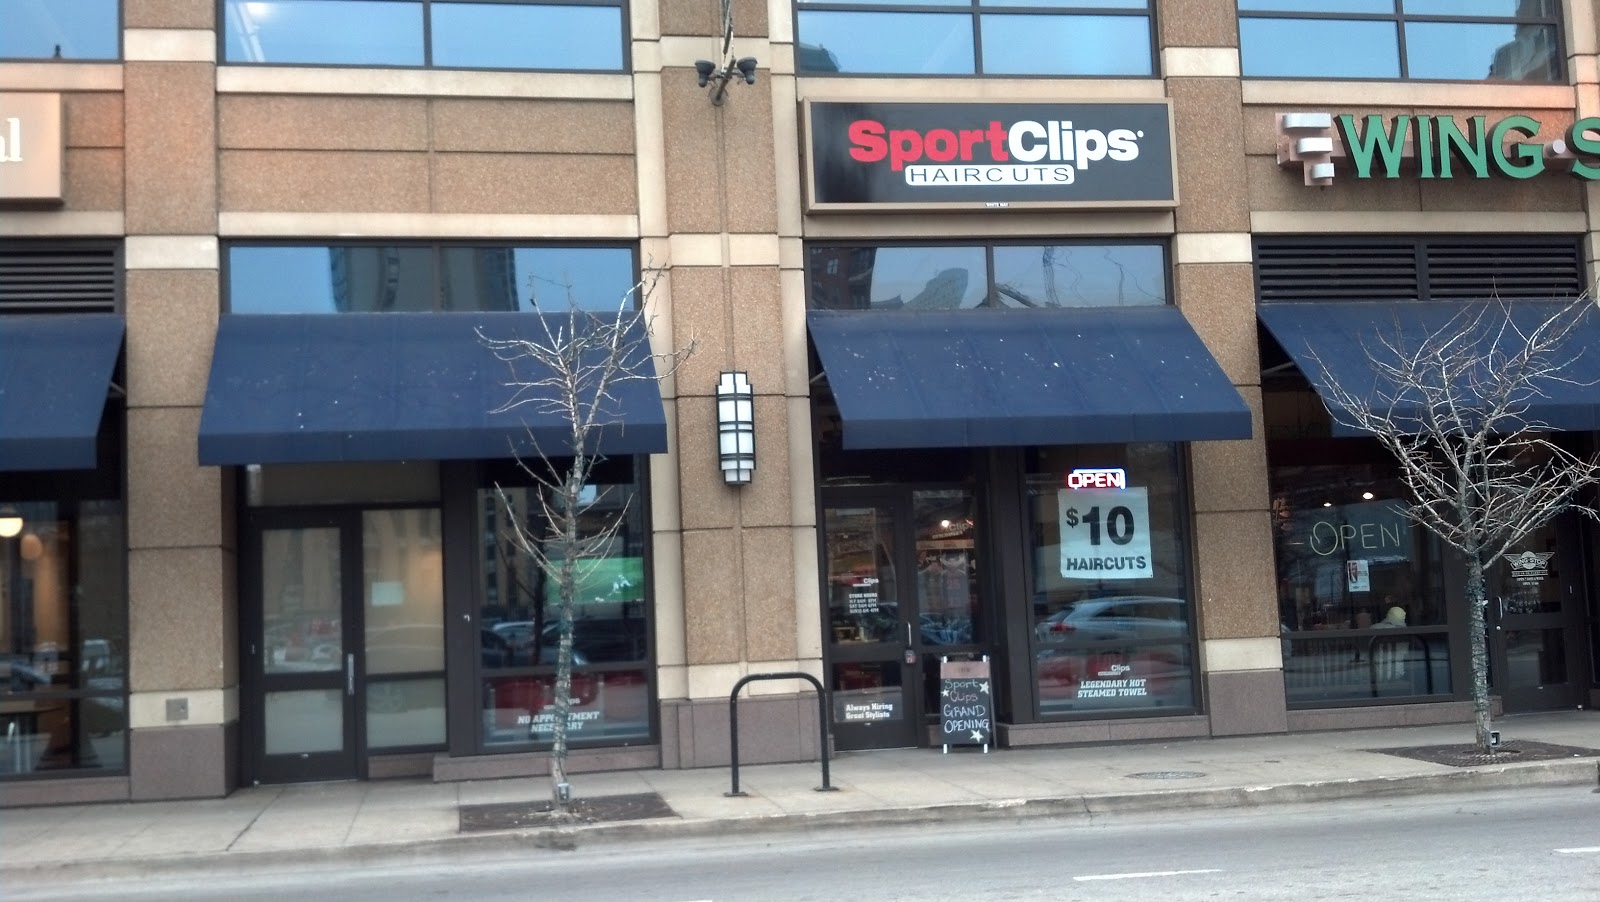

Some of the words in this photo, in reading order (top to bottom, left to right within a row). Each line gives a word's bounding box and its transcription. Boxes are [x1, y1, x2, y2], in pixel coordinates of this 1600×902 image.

[910, 167, 1070, 183] HAIRCUTS
[1067, 472, 1121, 490] OPEN
[1066, 505, 1135, 546] $10
[1309, 521, 1401, 556] OPEN
[1066, 556, 1147, 571] HAIRCUTS
[1111, 664, 1131, 673] Clips
[944, 679, 979, 691] Sport
[1080, 679, 1128, 689] LEGENDARY
[1128, 678, 1147, 687] HOT
[1077, 688, 1117, 698] STEAMED
[1117, 687, 1147, 697] TOWEL
[943, 704, 986, 718] GRAND
[517, 715, 531, 724] NO
[944, 719, 990, 733] OPENING
